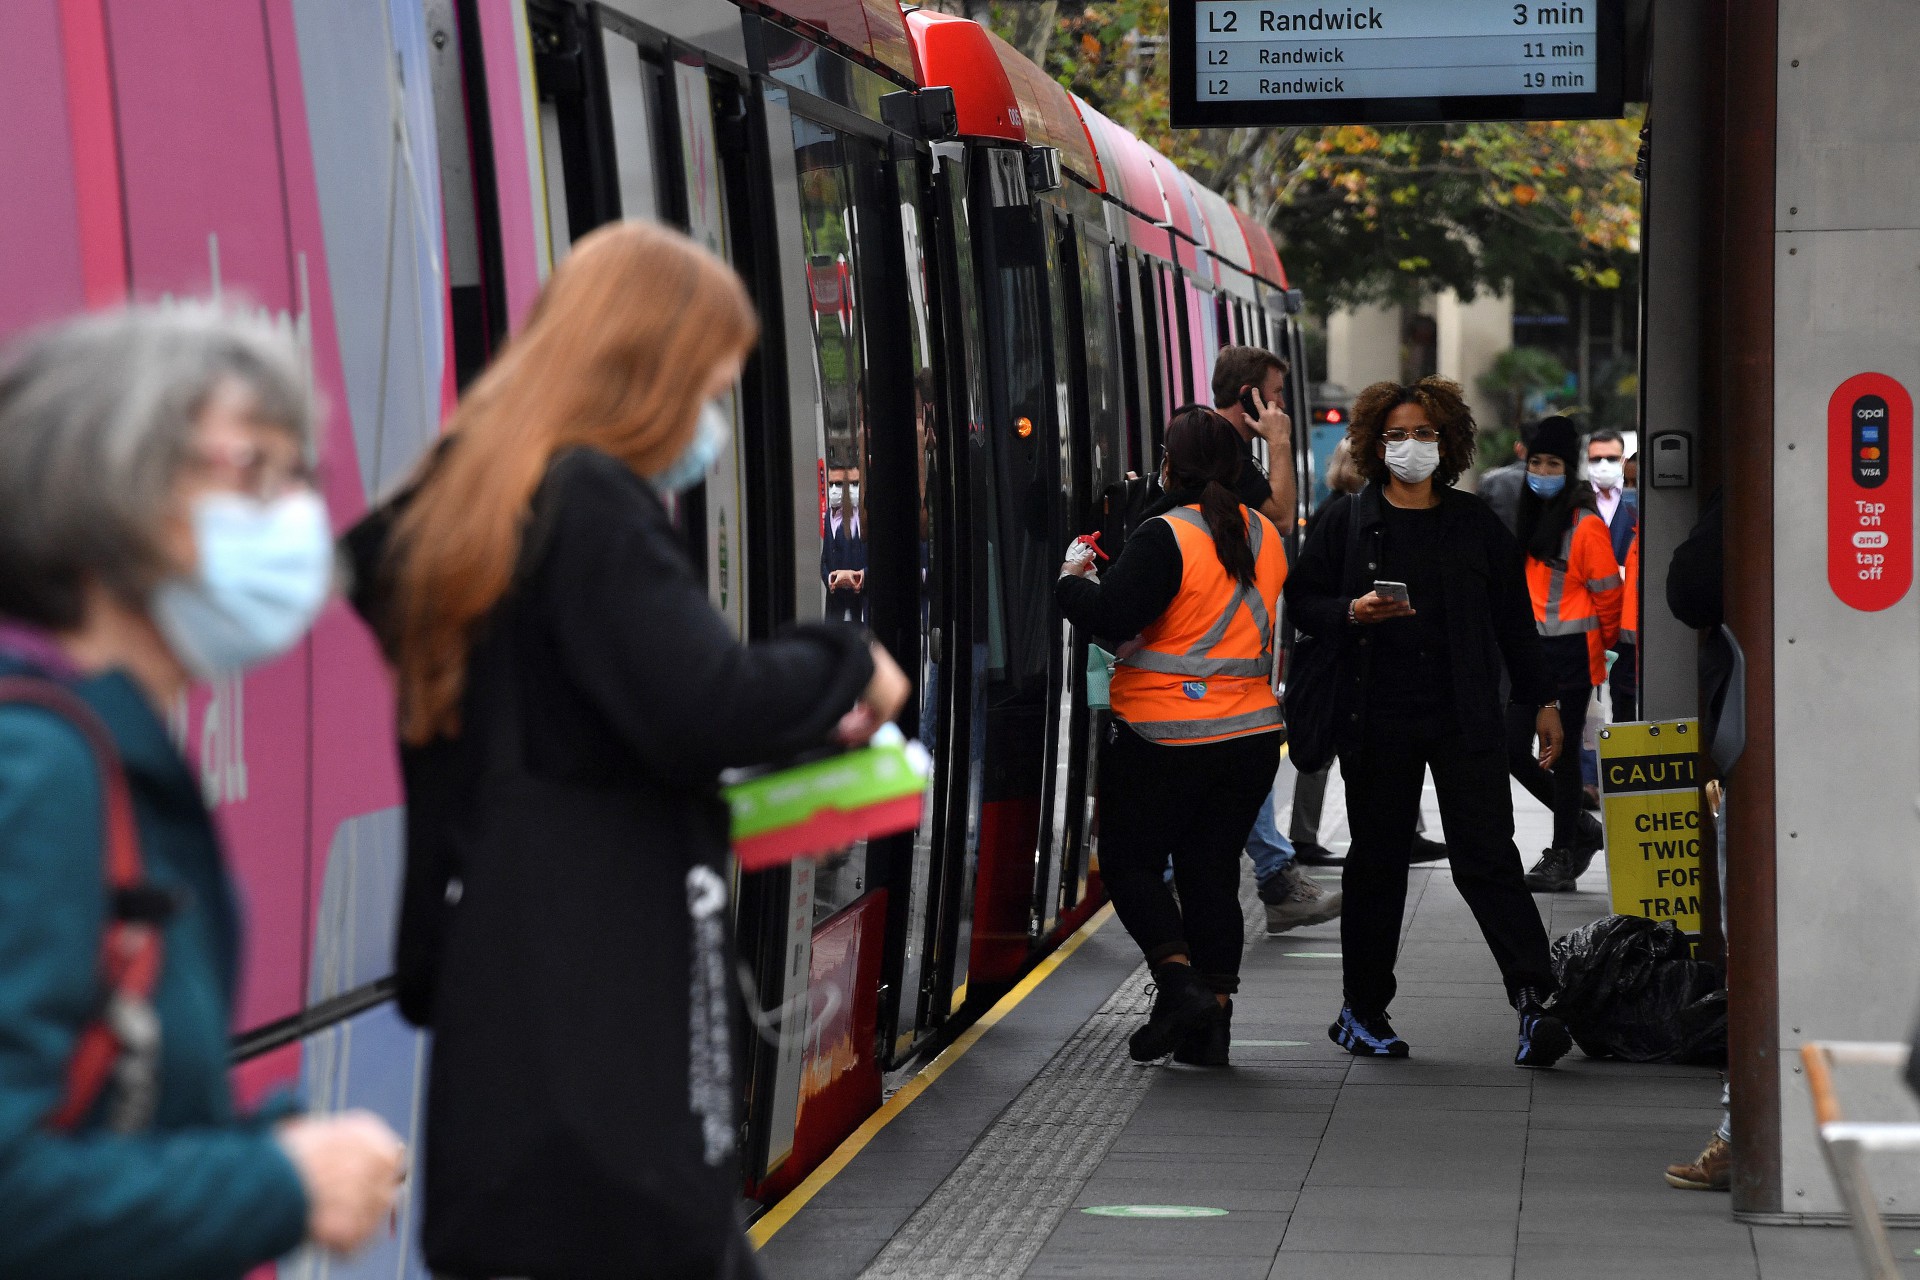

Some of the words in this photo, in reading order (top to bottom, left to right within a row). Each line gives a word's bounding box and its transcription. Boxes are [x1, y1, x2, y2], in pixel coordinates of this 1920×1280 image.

[1209, 11, 1238, 32] L2
[1260, 7, 1383, 31] Randwick
[1513, 3, 1528, 25] 3
[1537, 2, 1583, 24] min
[1208, 50, 1229, 65] L2
[1259, 47, 1344, 64] Randwick
[1523, 43, 1546, 57] 11
[1552, 41, 1584, 57] min
[1208, 80, 1229, 95] L2
[1259, 77, 1344, 94] Randwick
[1523, 72, 1546, 87] 19
[1552, 71, 1584, 87] min
[1857, 408, 1884, 420] opal
[1860, 468, 1881, 477] VISA
[1855, 500, 1886, 516] Tap
[1860, 515, 1881, 526] on
[1858, 535, 1882, 545] and
[1856, 552, 1885, 567] tap
[1858, 566, 1883, 580] off
[1609, 761, 1695, 785] CAUTI
[1635, 810, 1701, 832] CHEC
